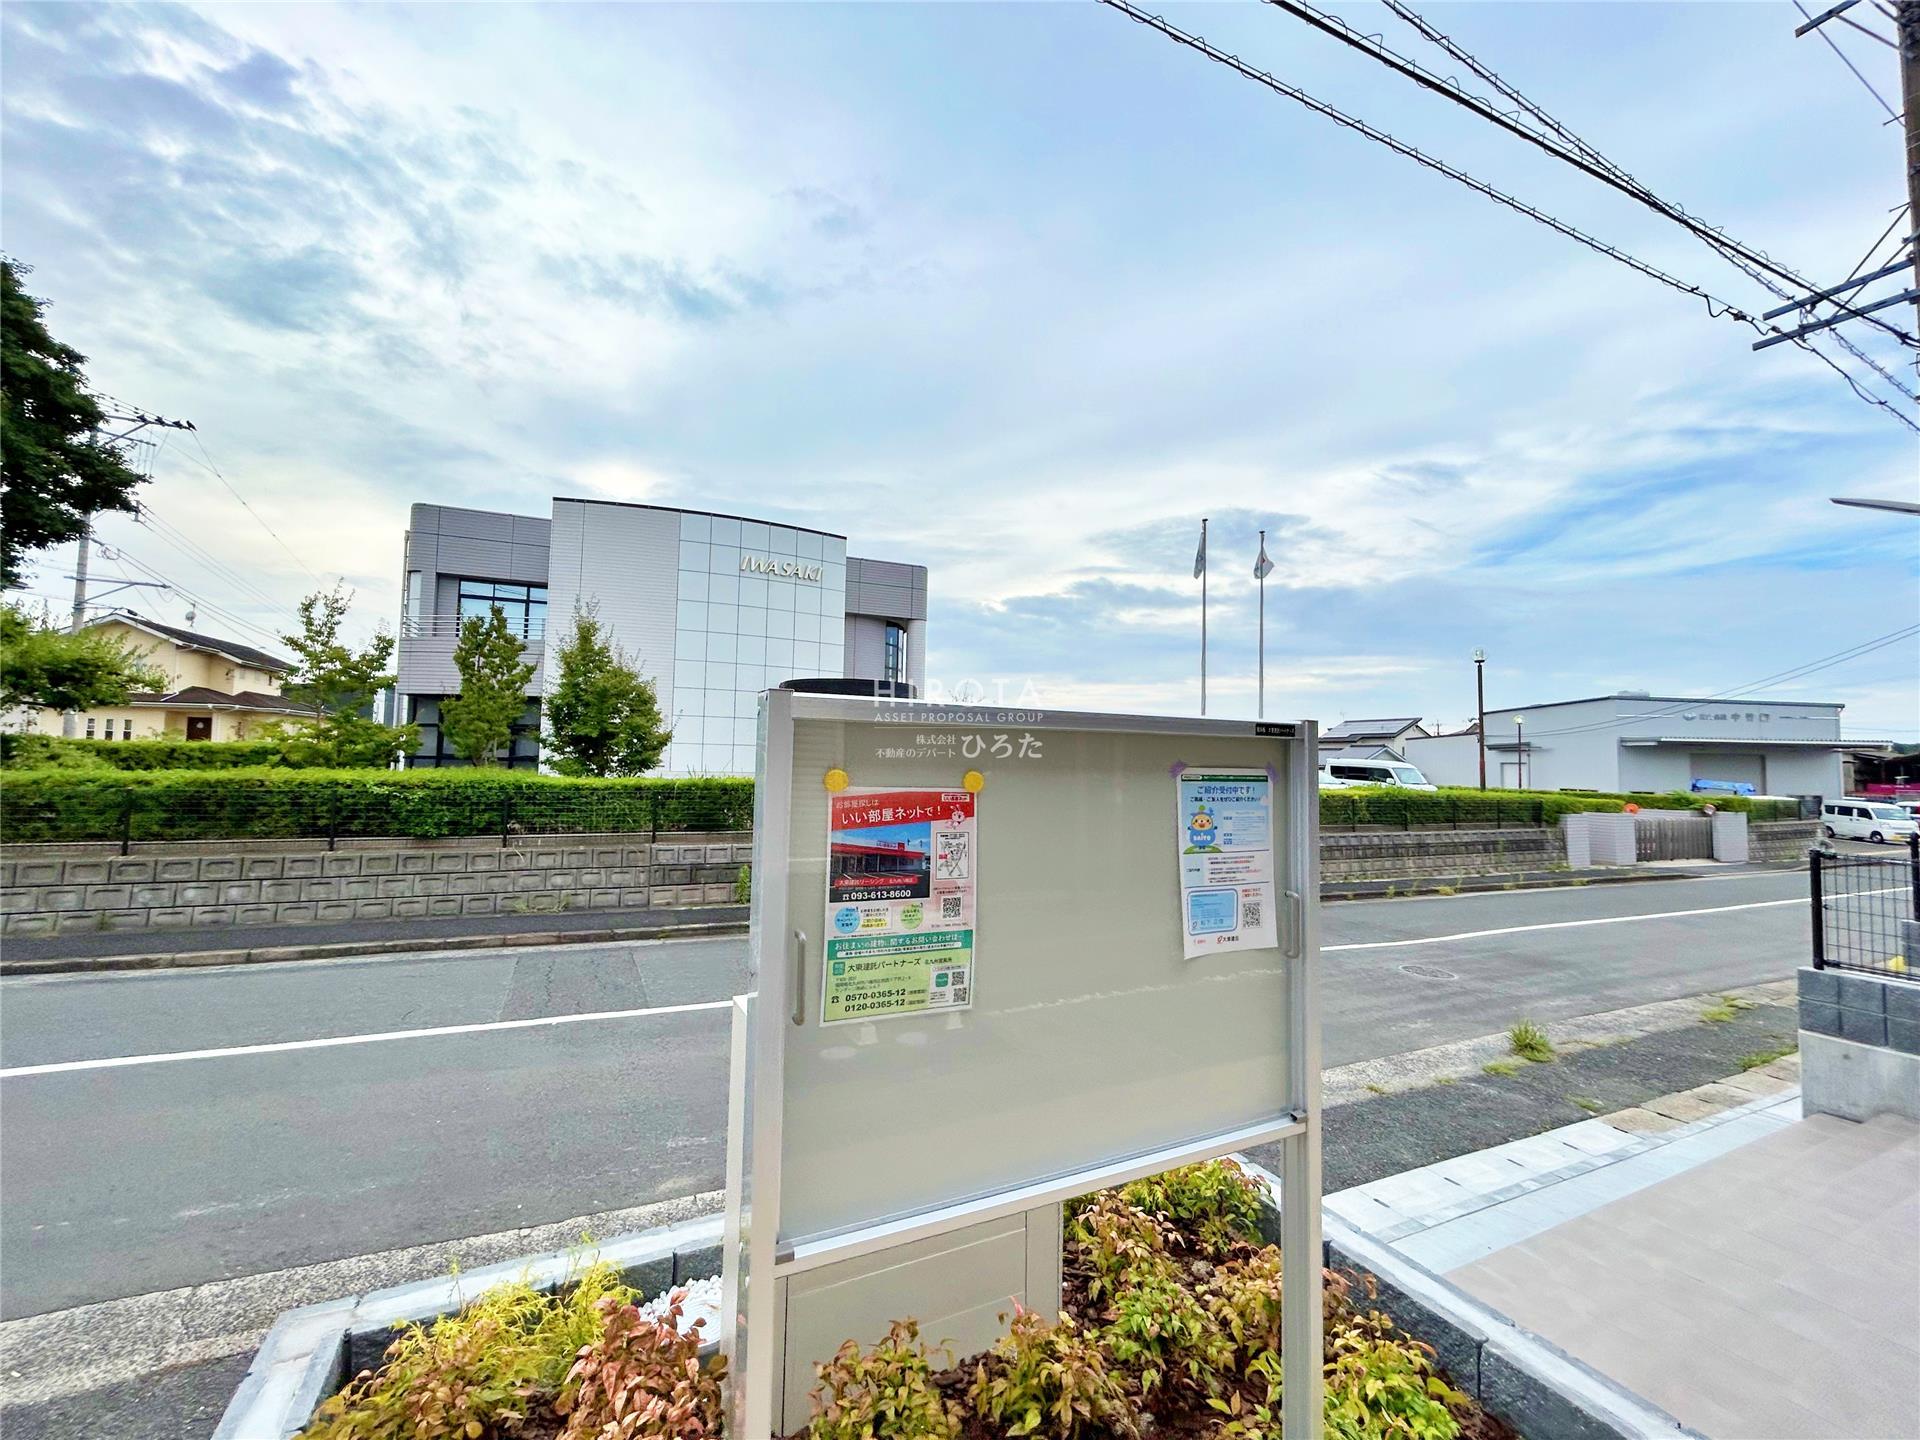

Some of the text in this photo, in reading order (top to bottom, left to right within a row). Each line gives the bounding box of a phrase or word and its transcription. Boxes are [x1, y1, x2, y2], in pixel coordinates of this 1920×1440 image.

[740, 555, 823, 582] IWASAKI
[850, 889, 912, 900] 093-613-8600
[845, 988, 907, 1002] 0570-0365-12
[844, 999, 906, 1013] 0120-0365-12
